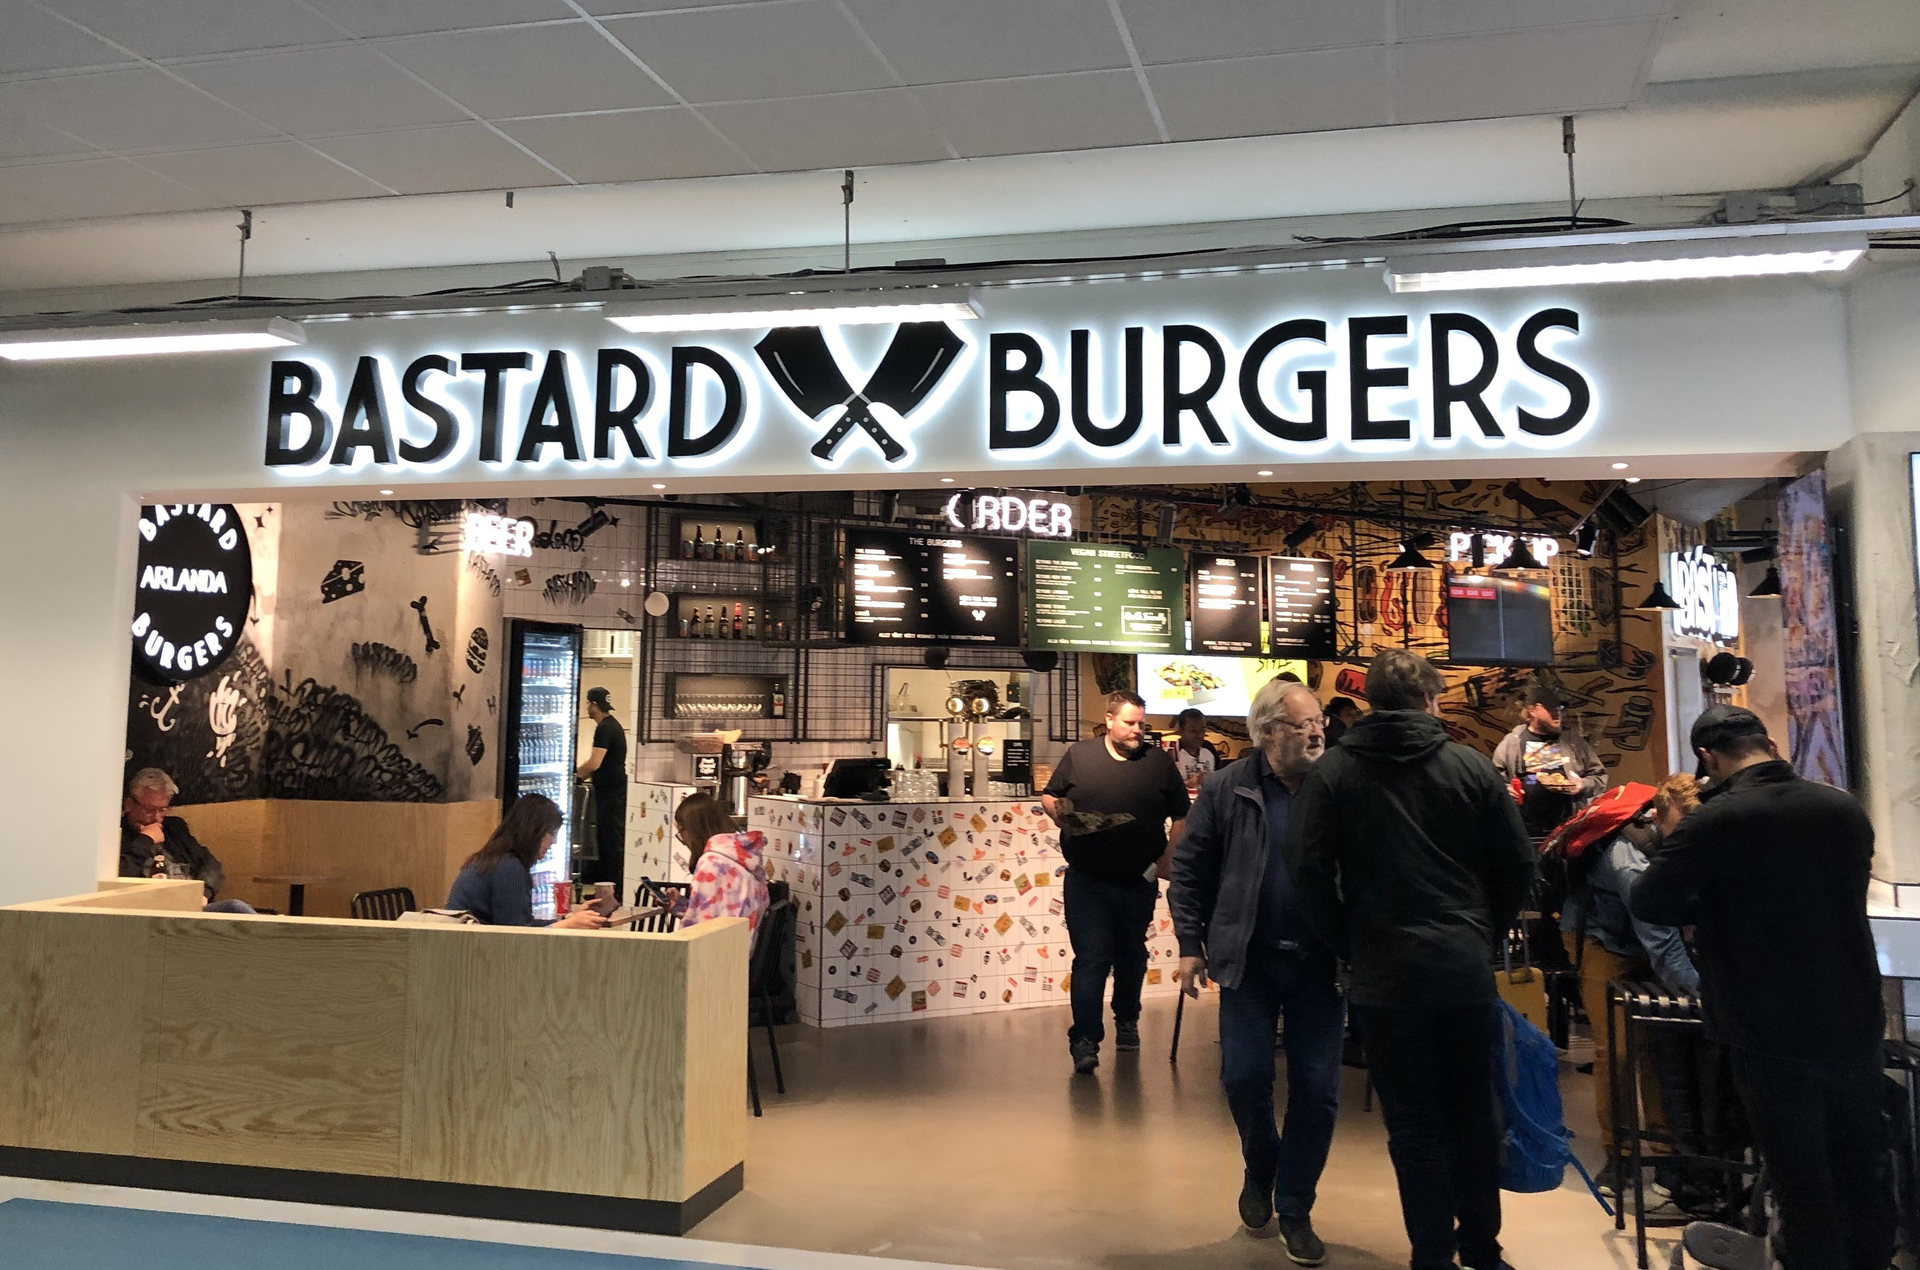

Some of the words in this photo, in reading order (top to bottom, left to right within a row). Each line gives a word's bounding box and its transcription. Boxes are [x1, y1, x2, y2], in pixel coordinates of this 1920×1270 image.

[265, 346, 747, 466] BASTARD
[989, 308, 1591, 450] BURGERS
[465, 513, 535, 557] BEER
[908, 537, 924, 546] THE
[926, 538, 963, 548] BURGERS
[1449, 532, 1514, 565] PCK
[1070, 548, 1097, 557] VEGAN
[1097, 549, 1146, 560] STREETFOOD
[140, 565, 228, 594] ARLANDA
[131, 612, 233, 671] BURGERS
